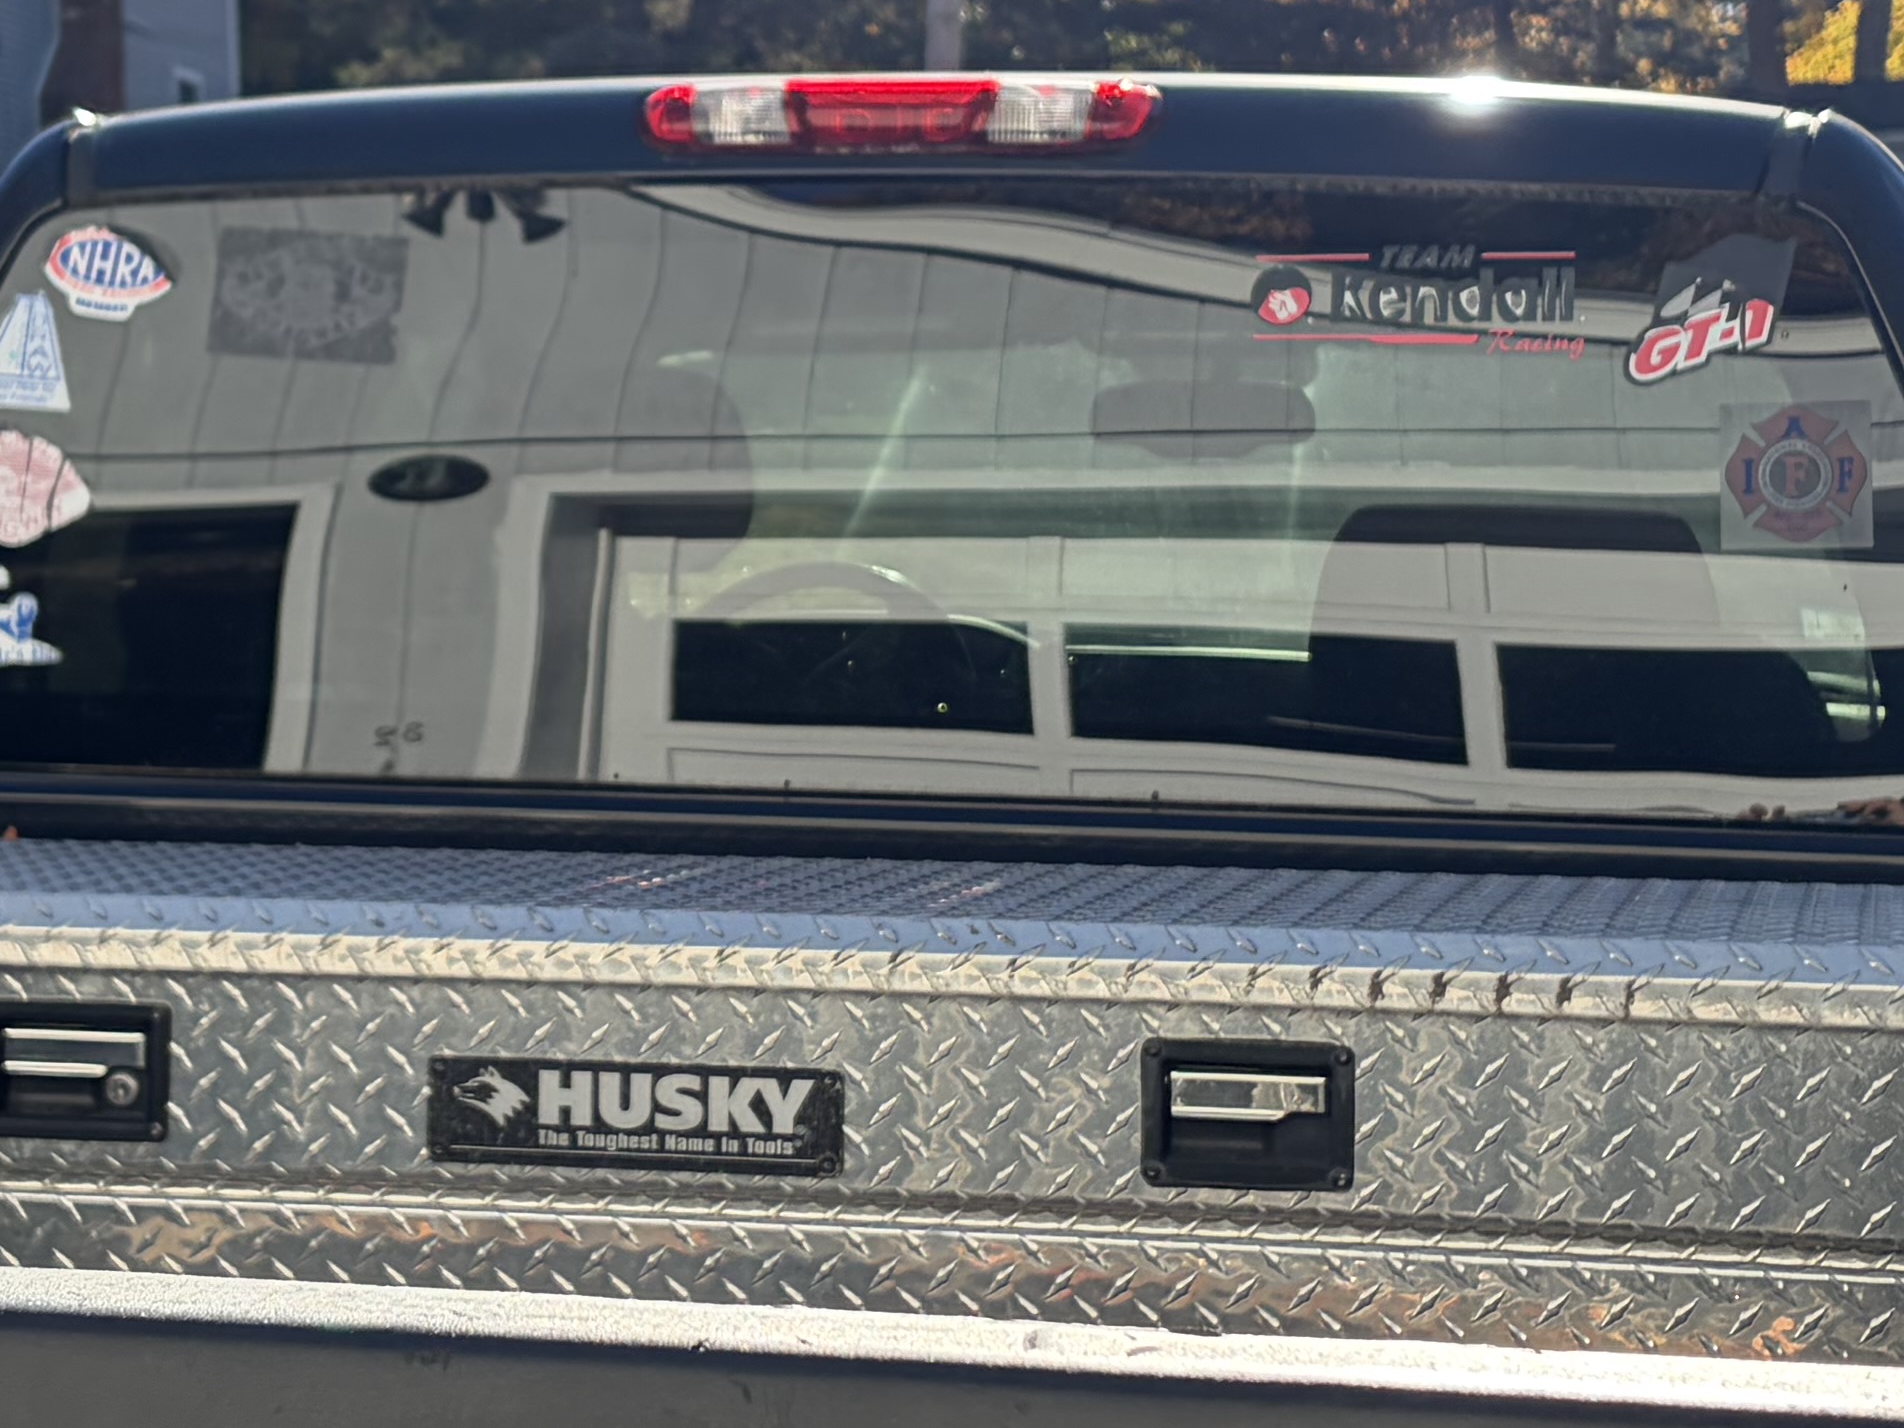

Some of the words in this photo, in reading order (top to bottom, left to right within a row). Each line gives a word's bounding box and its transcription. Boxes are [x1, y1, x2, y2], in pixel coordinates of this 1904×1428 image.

[68, 240, 157, 288] NHRA
[1380, 244, 1477, 269] TEAM
[1487, 328, 1586, 360] Racing
[1629, 297, 1775, 382] GT-1
[537, 1069, 817, 1135] HUSKY
[538, 1129, 569, 1147] The
[576, 1130, 659, 1152] Toughest
[664, 1134, 714, 1152] Name
[745, 1137, 793, 1156] Tools
